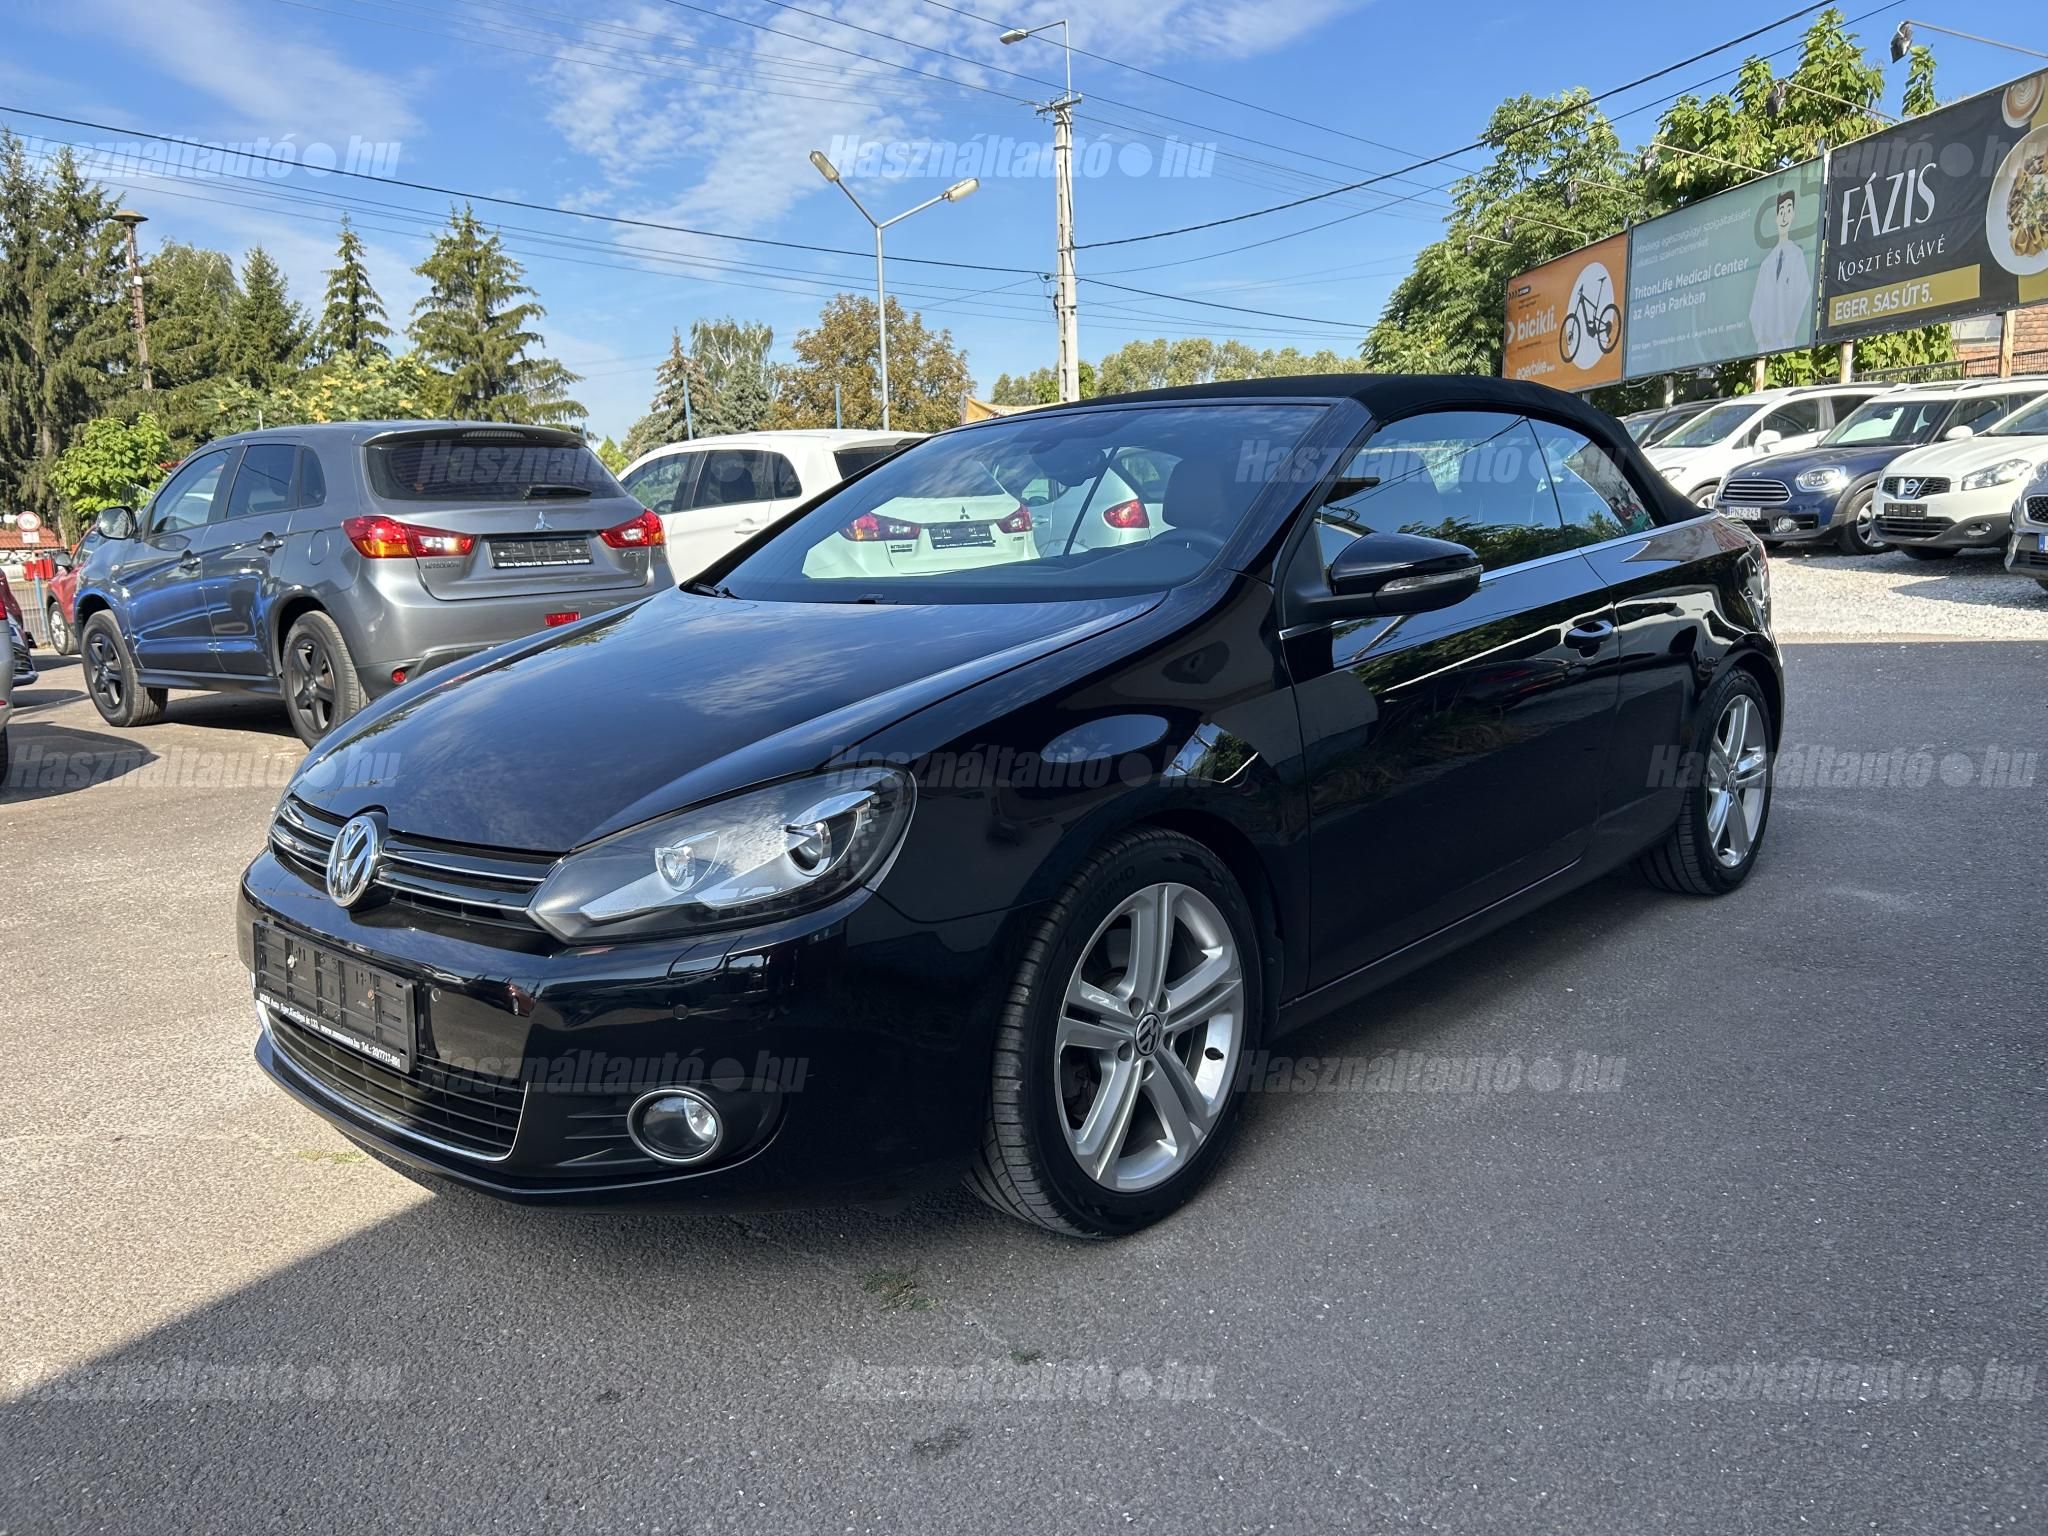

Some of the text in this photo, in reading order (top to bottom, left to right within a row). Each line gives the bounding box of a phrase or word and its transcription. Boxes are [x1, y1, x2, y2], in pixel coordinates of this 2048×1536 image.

[1840, 162, 1937, 246] FÁZIS
[1634, 258, 1750, 300] TritonLife Medical Center
[1632, 291, 1706, 321] az Agria Parkban
[1835, 283, 1933, 320] EGER, SAS ÚT 5.
[1516, 305, 1557, 342] bicikli.
